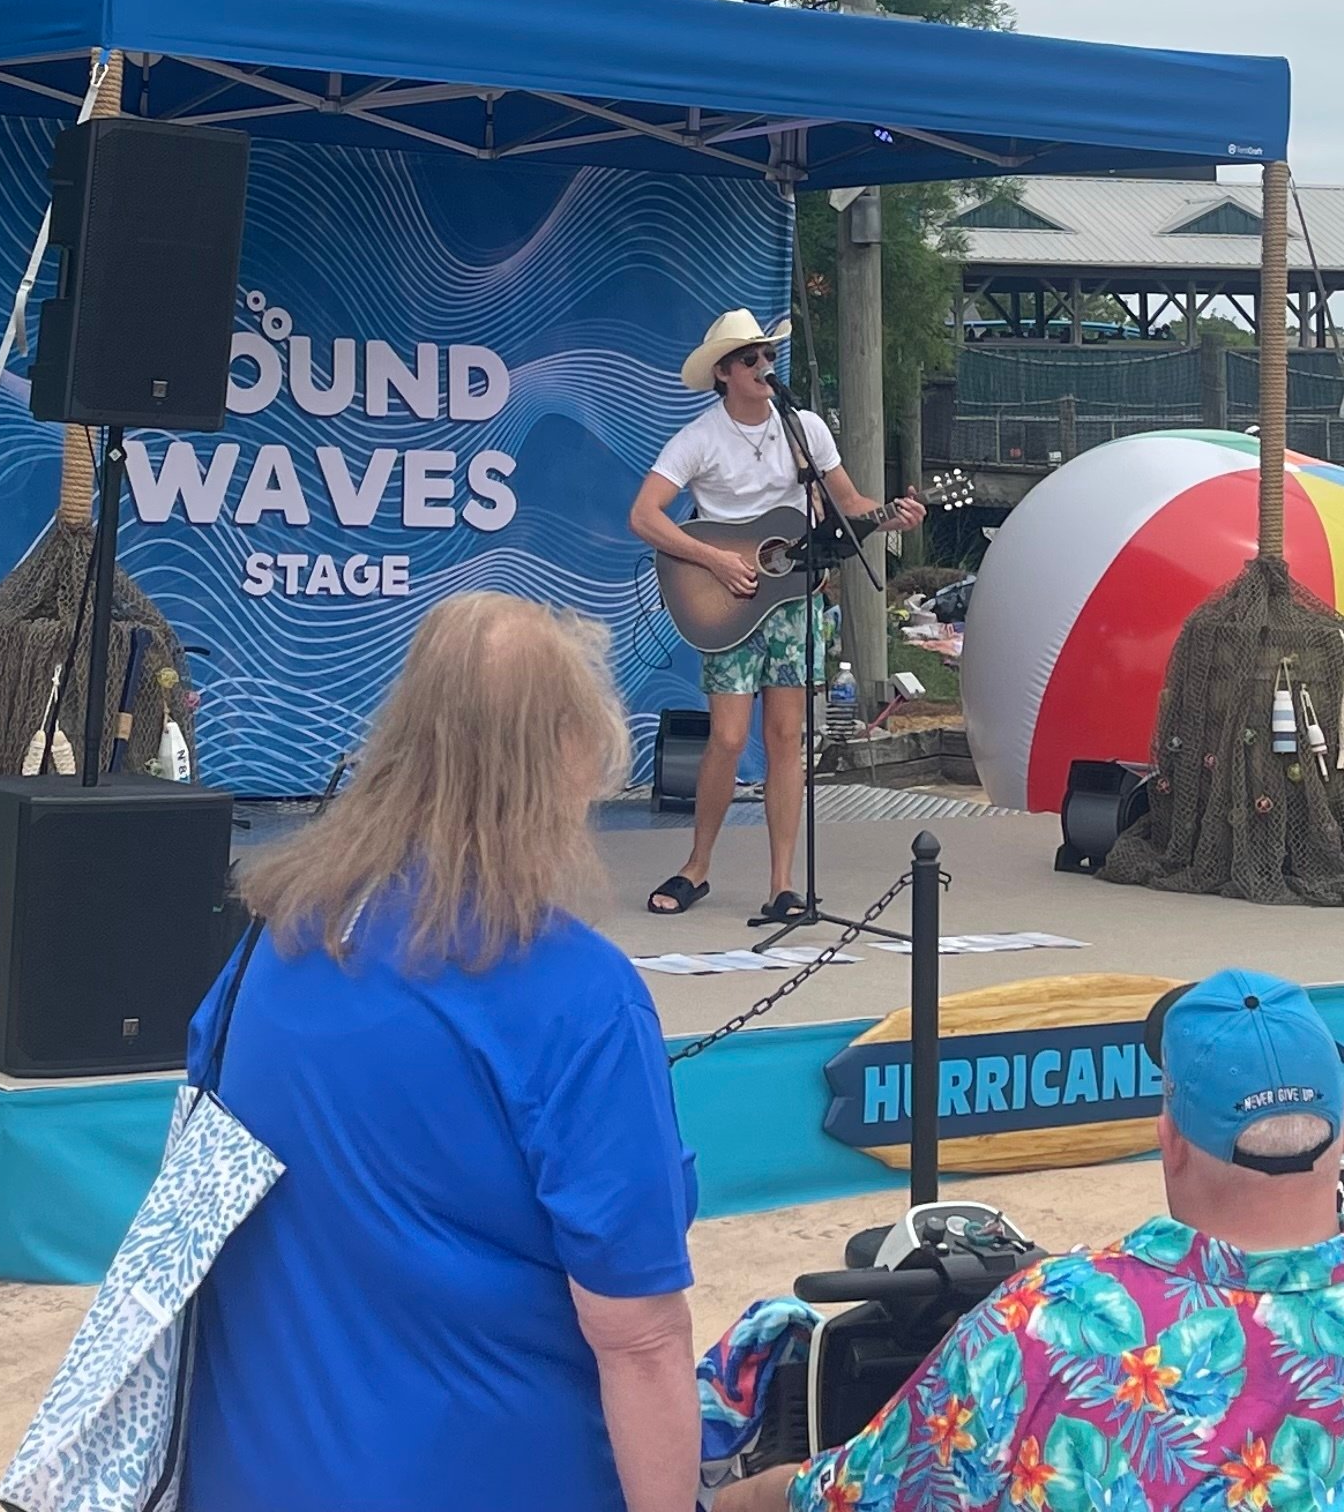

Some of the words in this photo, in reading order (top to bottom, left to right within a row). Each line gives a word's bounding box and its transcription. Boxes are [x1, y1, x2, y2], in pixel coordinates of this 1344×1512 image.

[225, 332, 511, 421] OUND
[123, 439, 518, 532] WAVES
[242, 553, 411, 598] STAGE
[863, 1042, 1164, 1124] HRRICANE
[1243, 1090, 1275, 1112] NEVER
[1277, 1087, 1300, 1103] GIVE
[1301, 1088, 1315, 1102] UP
